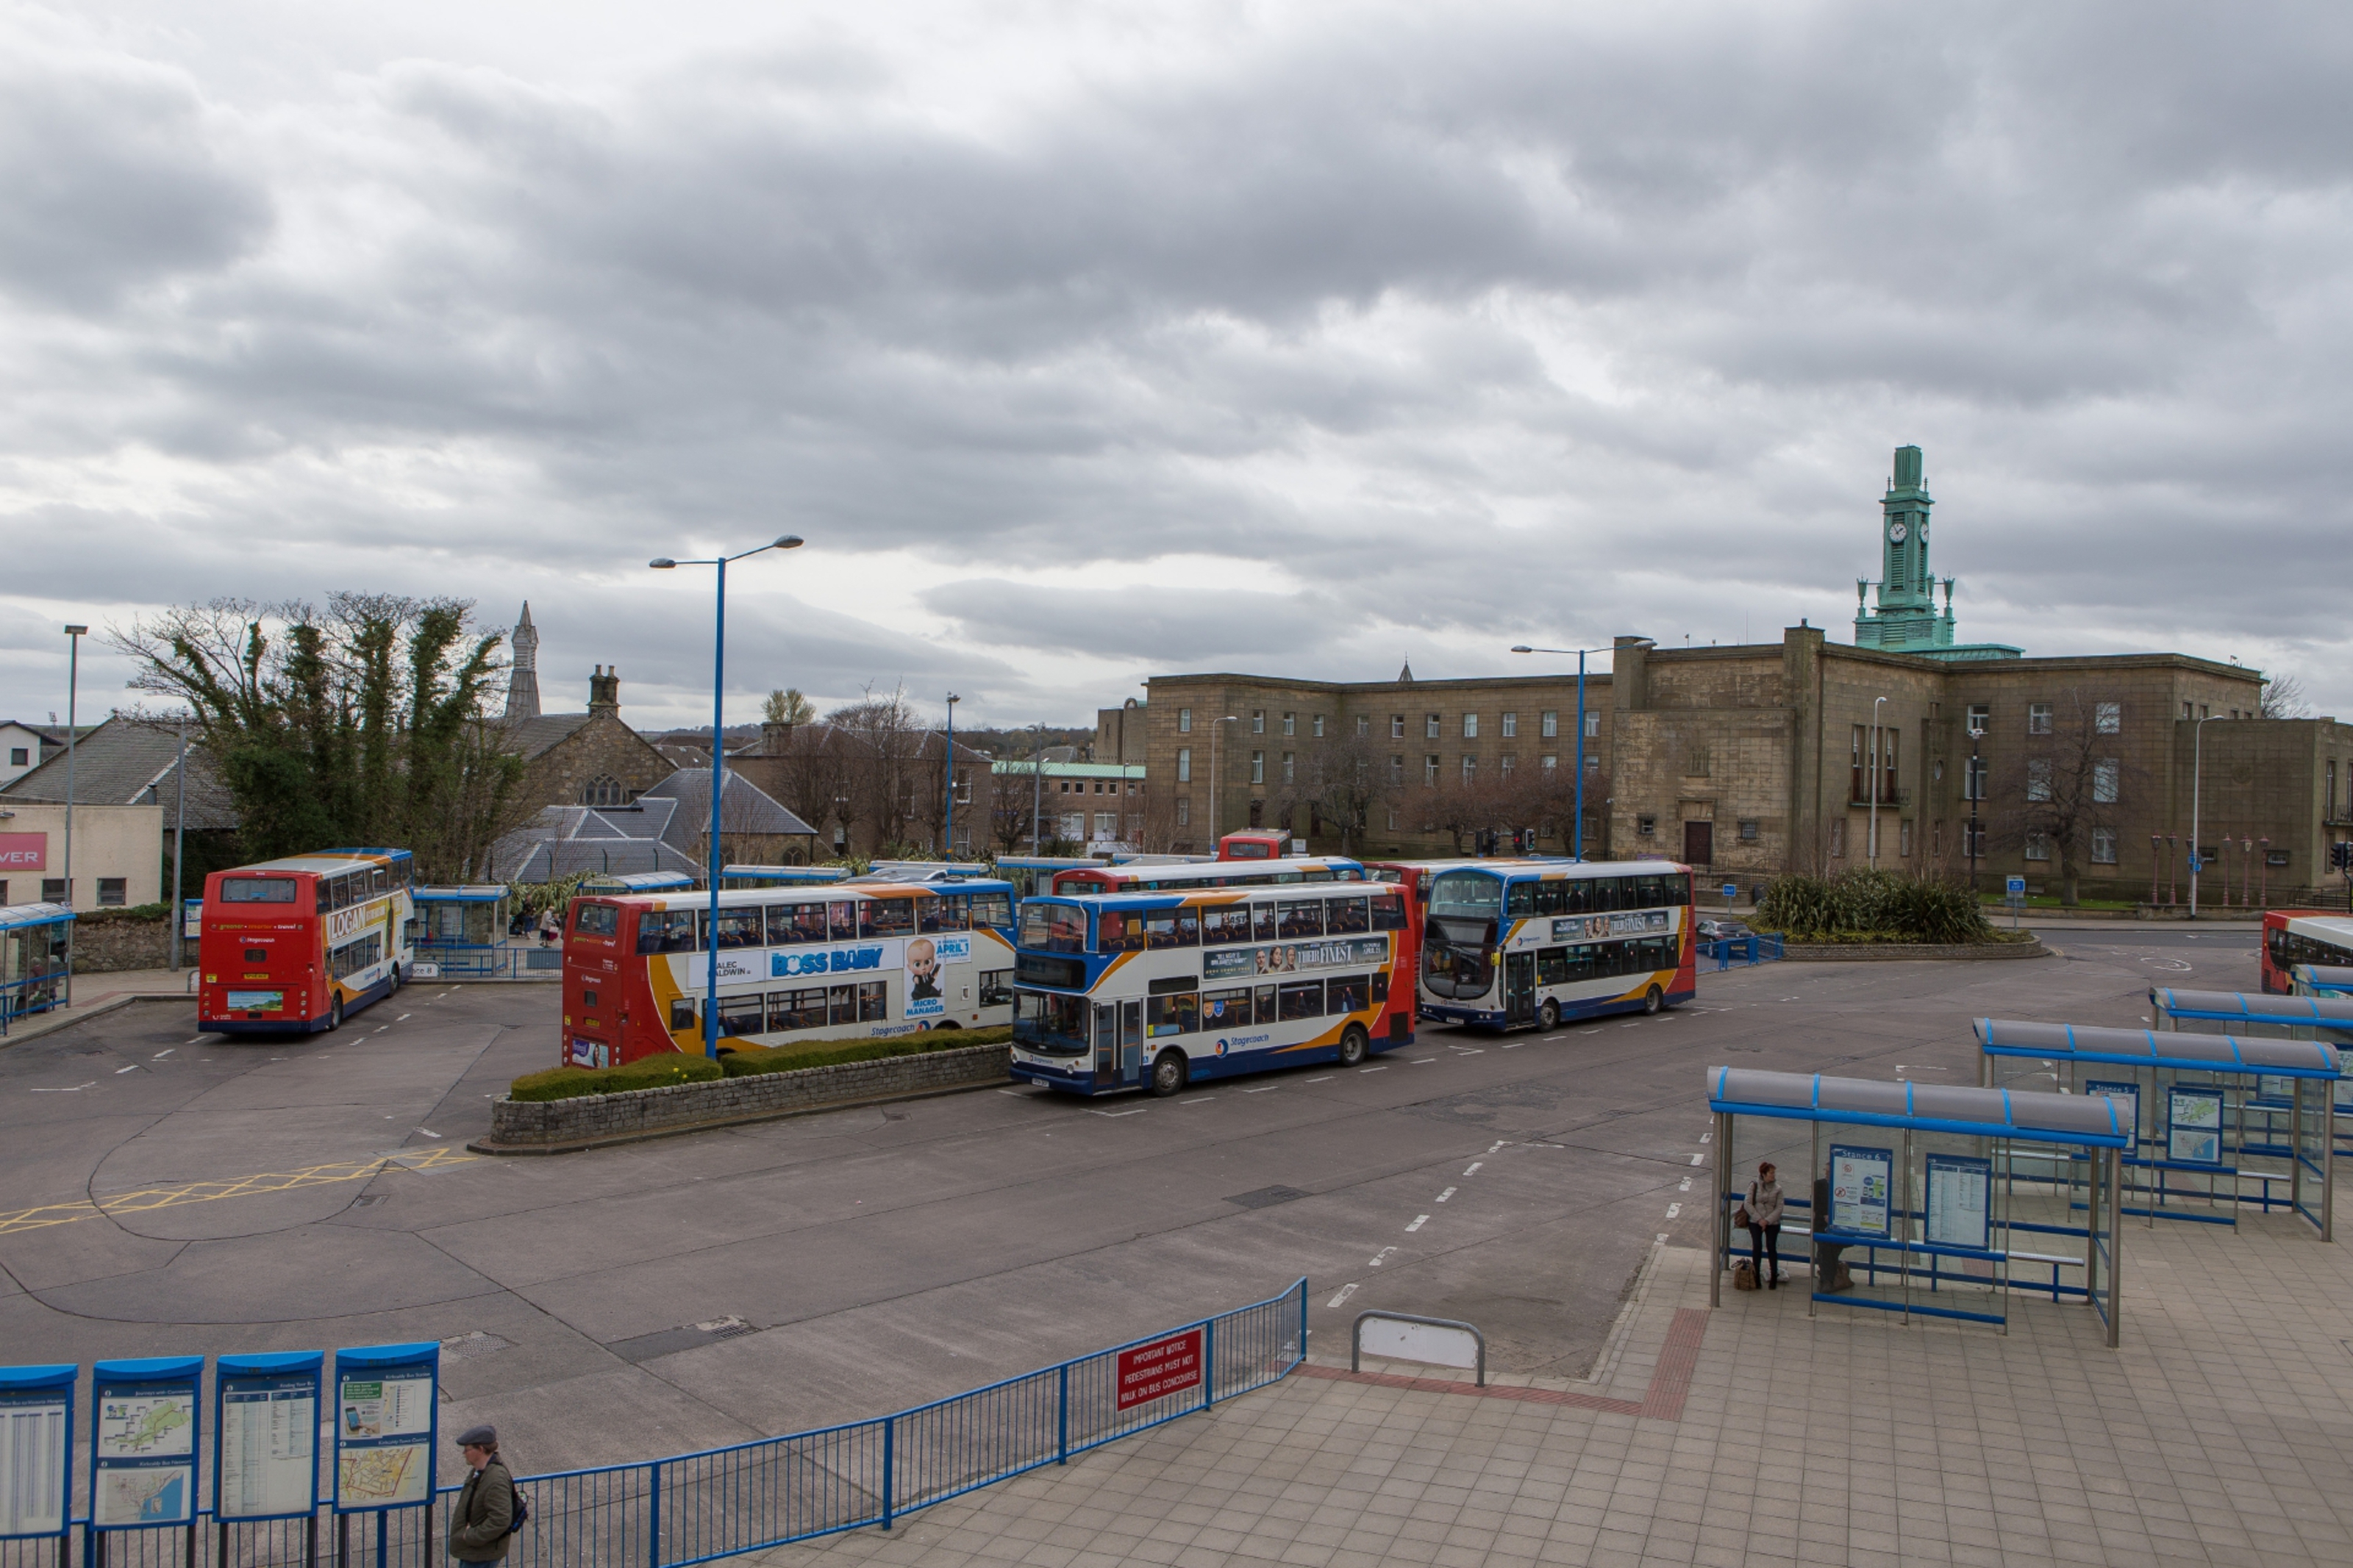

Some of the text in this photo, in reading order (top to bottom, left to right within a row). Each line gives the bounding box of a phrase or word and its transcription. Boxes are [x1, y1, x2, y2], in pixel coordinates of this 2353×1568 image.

[332, 906, 366, 939] LOGAN
[936, 942, 969, 955] APRIL 1
[1297, 945, 1352, 964] THEIR FINEST
[716, 962, 738, 970] ALEC
[771, 948, 884, 977] BOSS BABY
[913, 998, 938, 1008] MICRO
[906, 1005, 944, 1016] MANAGER
[871, 1024, 915, 1037] Stagecoach
[1230, 1034, 1270, 1046] Stagecoach
[1842, 1150, 1872, 1160] Stance
[1133, 1339, 1187, 1365] IMPORTANT NOTICE
[1124, 1354, 1194, 1385] PEDESTRIANS MUST NOT
[1121, 1370, 1198, 1403] WALK ON BUS CONCOURSE
